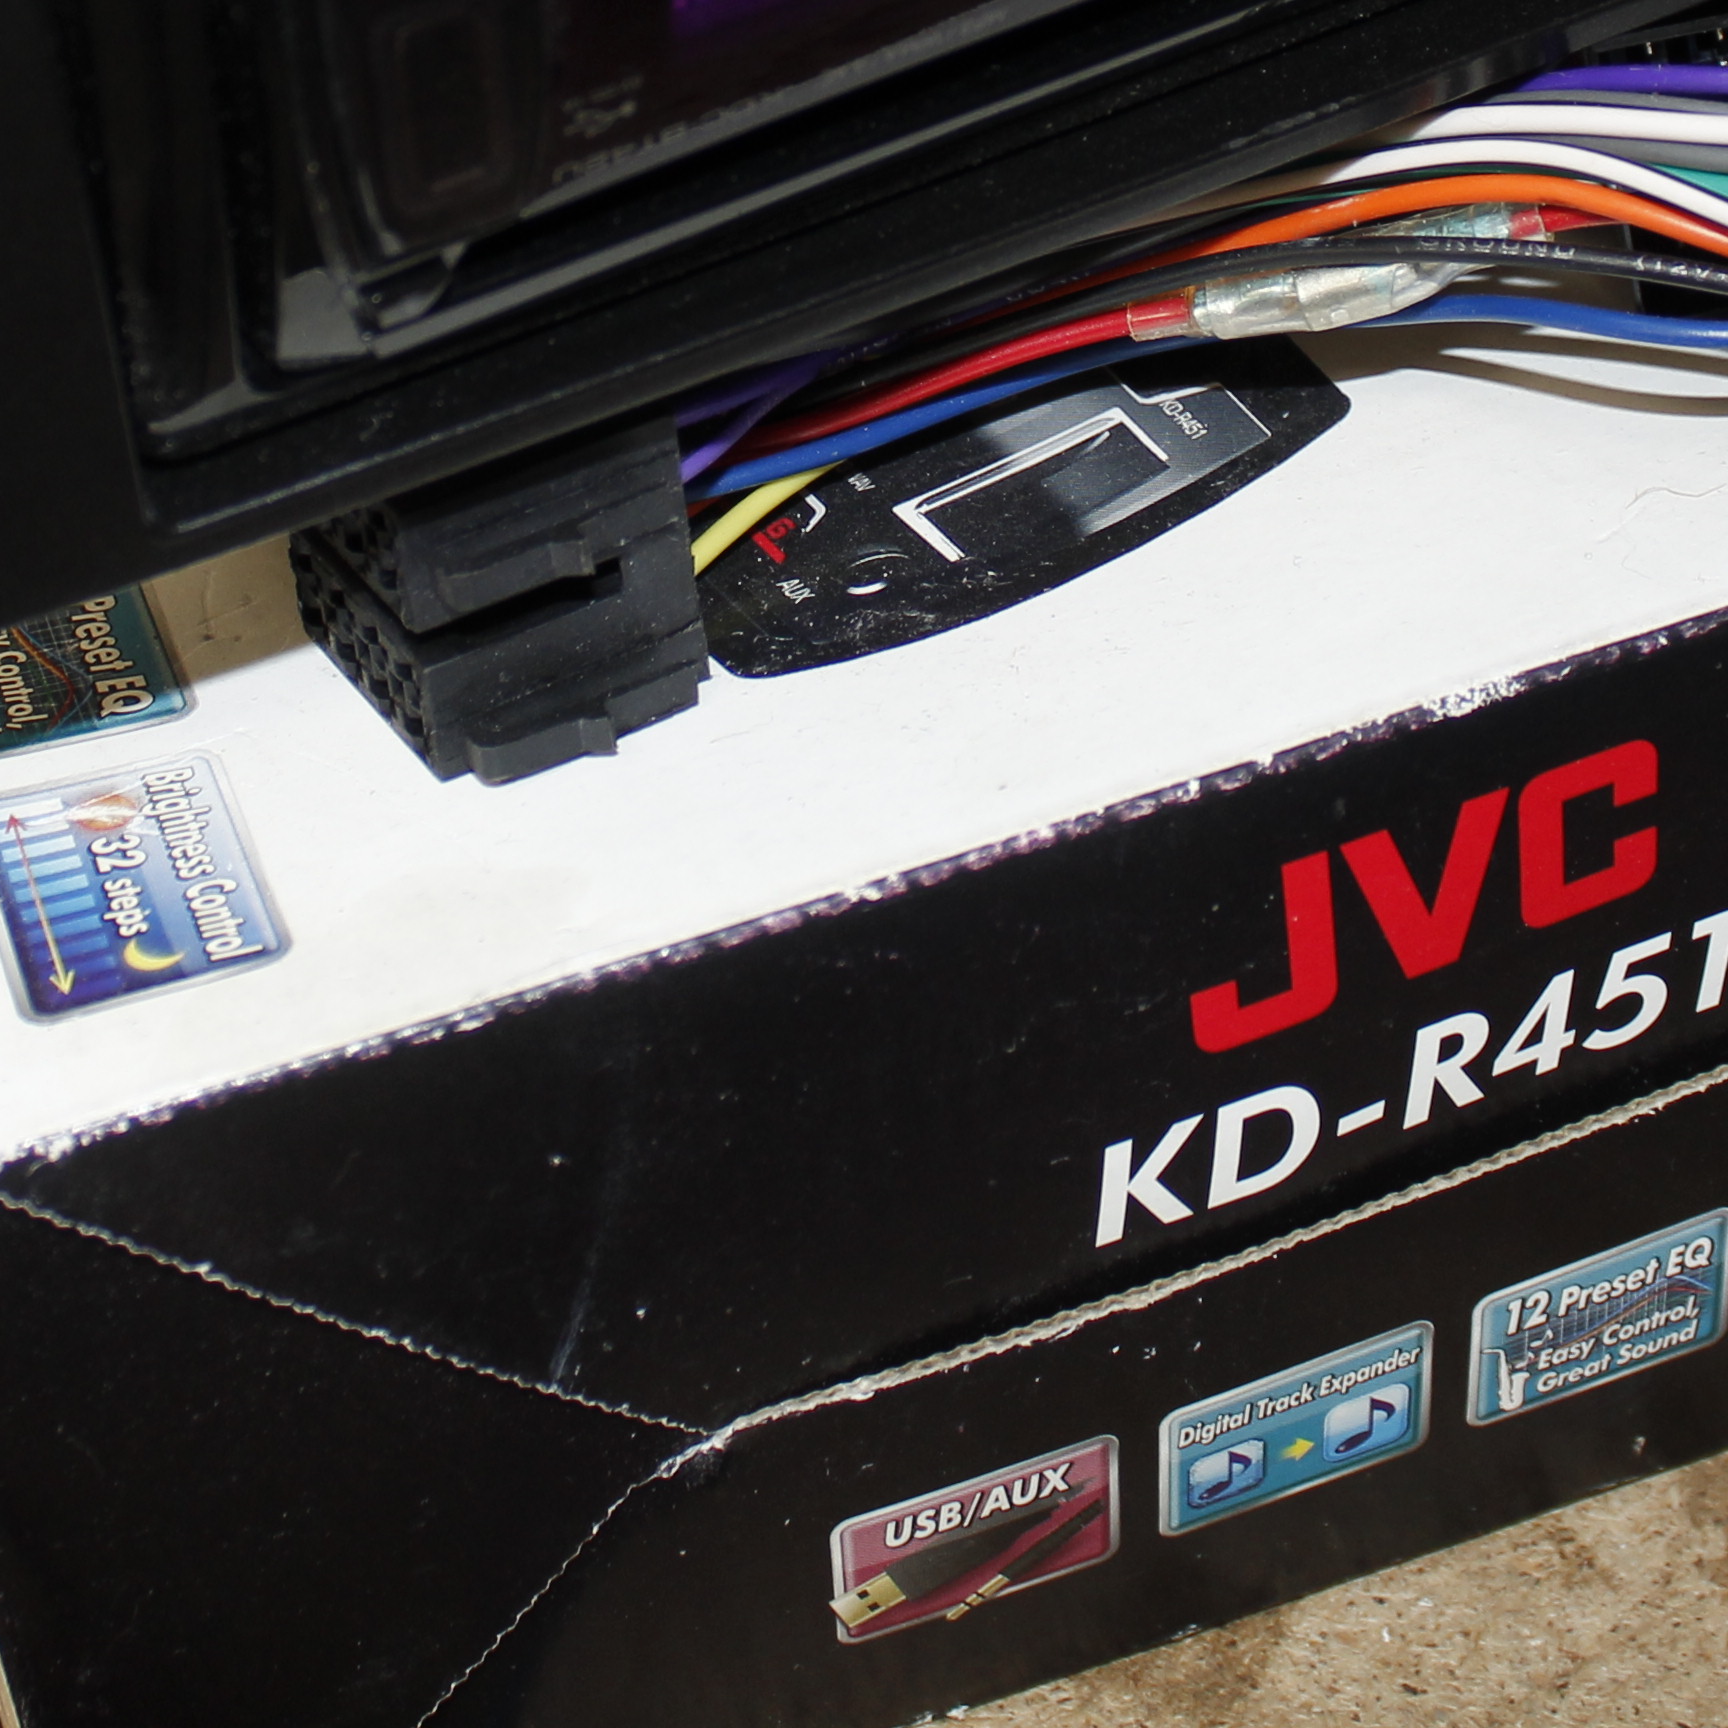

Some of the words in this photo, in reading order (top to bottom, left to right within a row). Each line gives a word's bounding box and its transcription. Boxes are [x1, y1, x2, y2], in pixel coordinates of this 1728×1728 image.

[1158, 398, 1208, 441] KD-R451
[776, 578, 815, 604] AUX
[71, 594, 133, 672] Preset
[94, 674, 156, 718] EQ
[89, 832, 148, 875] 32
[140, 766, 217, 881] Brightness
[185, 878, 265, 962] Control
[103, 877, 149, 938] steps
[1190, 739, 1658, 1053] JVC
[1506, 1289, 1551, 1336] 12
[1558, 1257, 1661, 1318] Preset
[1666, 1236, 1714, 1278] EQ
[1536, 1353, 1612, 1393] Great
[1616, 1318, 1700, 1366] Sound
[1537, 1337, 1597, 1371] Easy
[1602, 1294, 1701, 1347] Control,
[1177, 1403, 1252, 1449] Digital
[1256, 1380, 1315, 1421] Track
[1318, 1346, 1422, 1398] Expander
[885, 1462, 1072, 1549] USB/AUX
